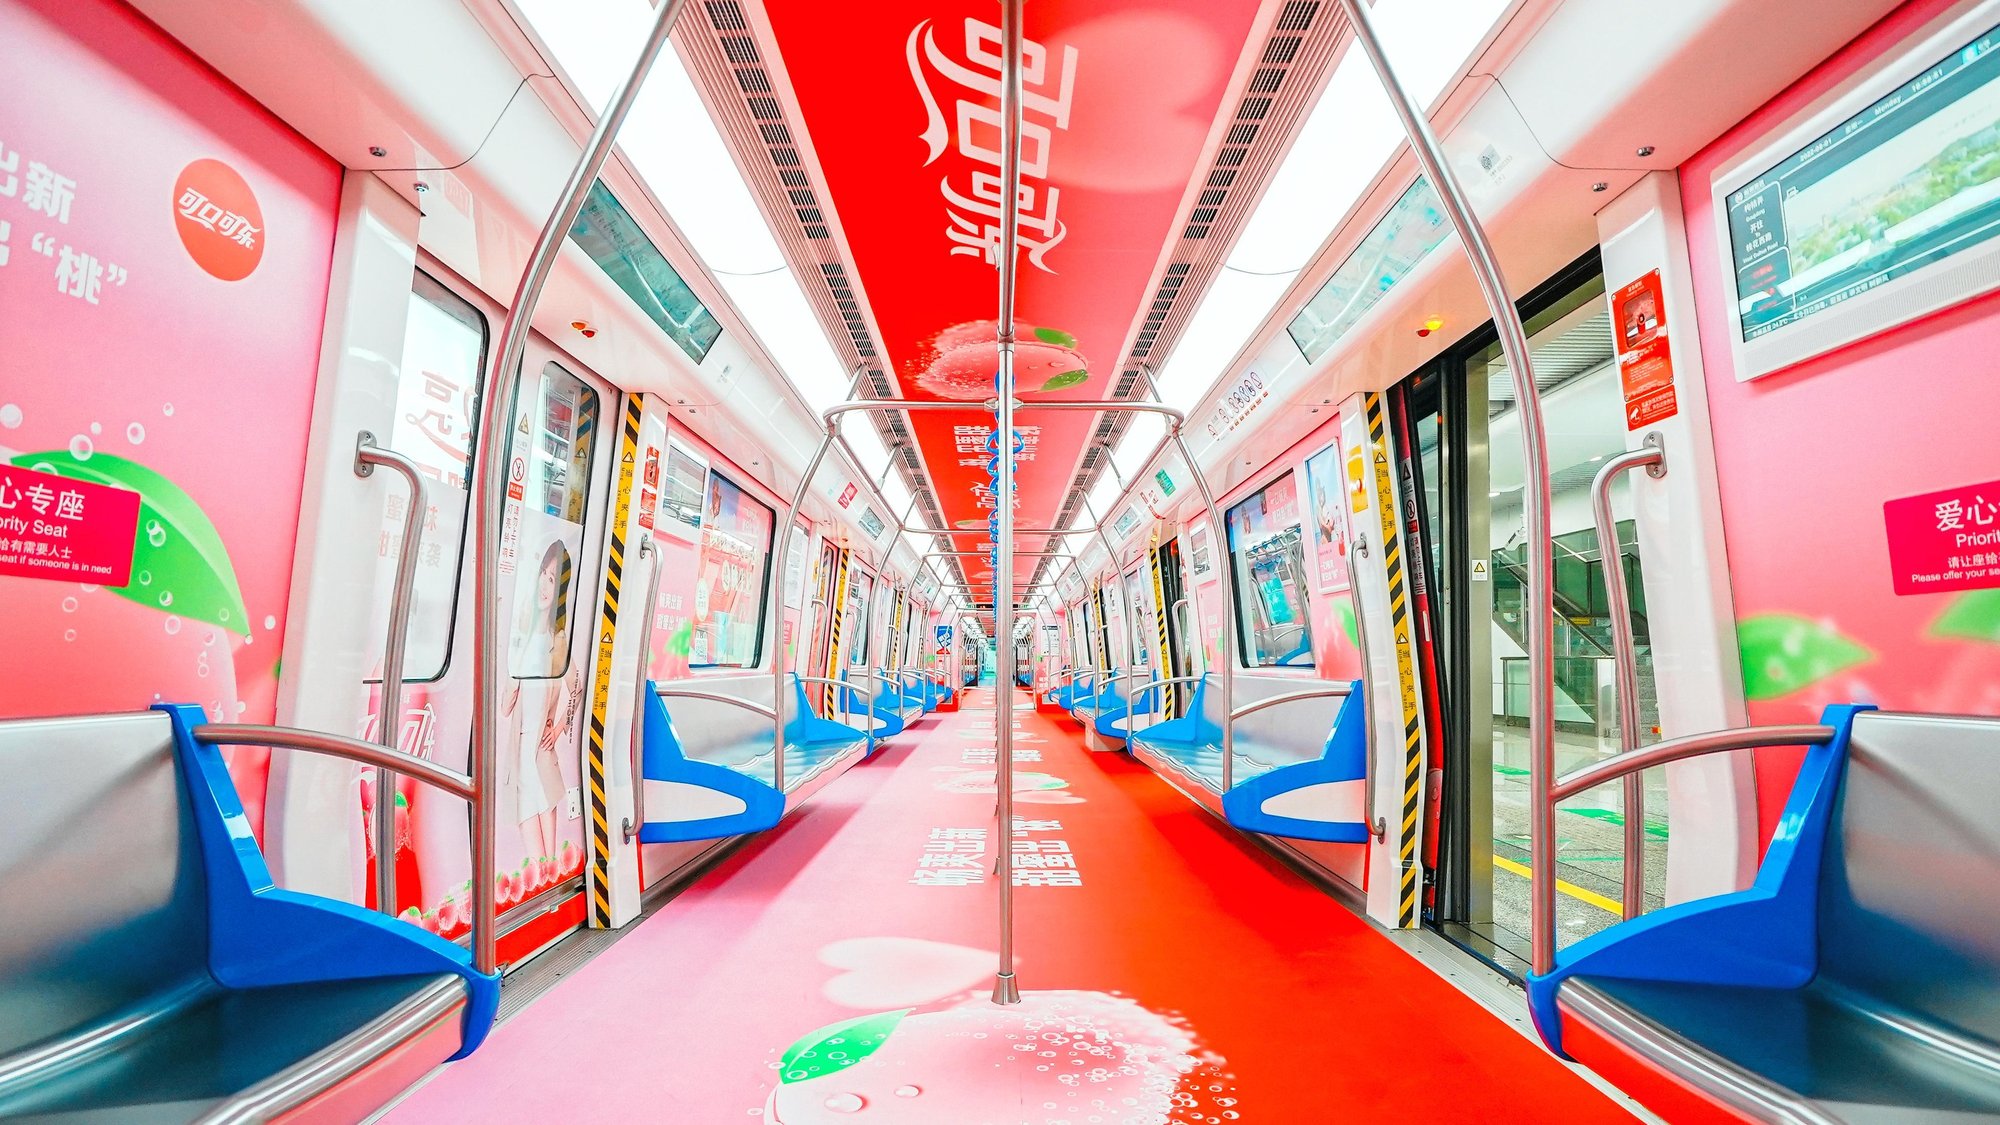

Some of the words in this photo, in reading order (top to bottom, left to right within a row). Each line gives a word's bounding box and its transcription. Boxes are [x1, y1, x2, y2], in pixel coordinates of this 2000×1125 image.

[178, 187, 261, 250] 可口可乐
[0, 220, 128, 305] “桃”
[33, 519, 68, 538] Seat
[19, 555, 27, 564] if
[28, 558, 70, 570] someone
[71, 561, 80, 570] is
[81, 562, 89, 571] in
[91, 563, 112, 575] need
[1911, 573, 1941, 583] Please
[1943, 570, 1963, 580] offer
[1965, 568, 1986, 580] your
